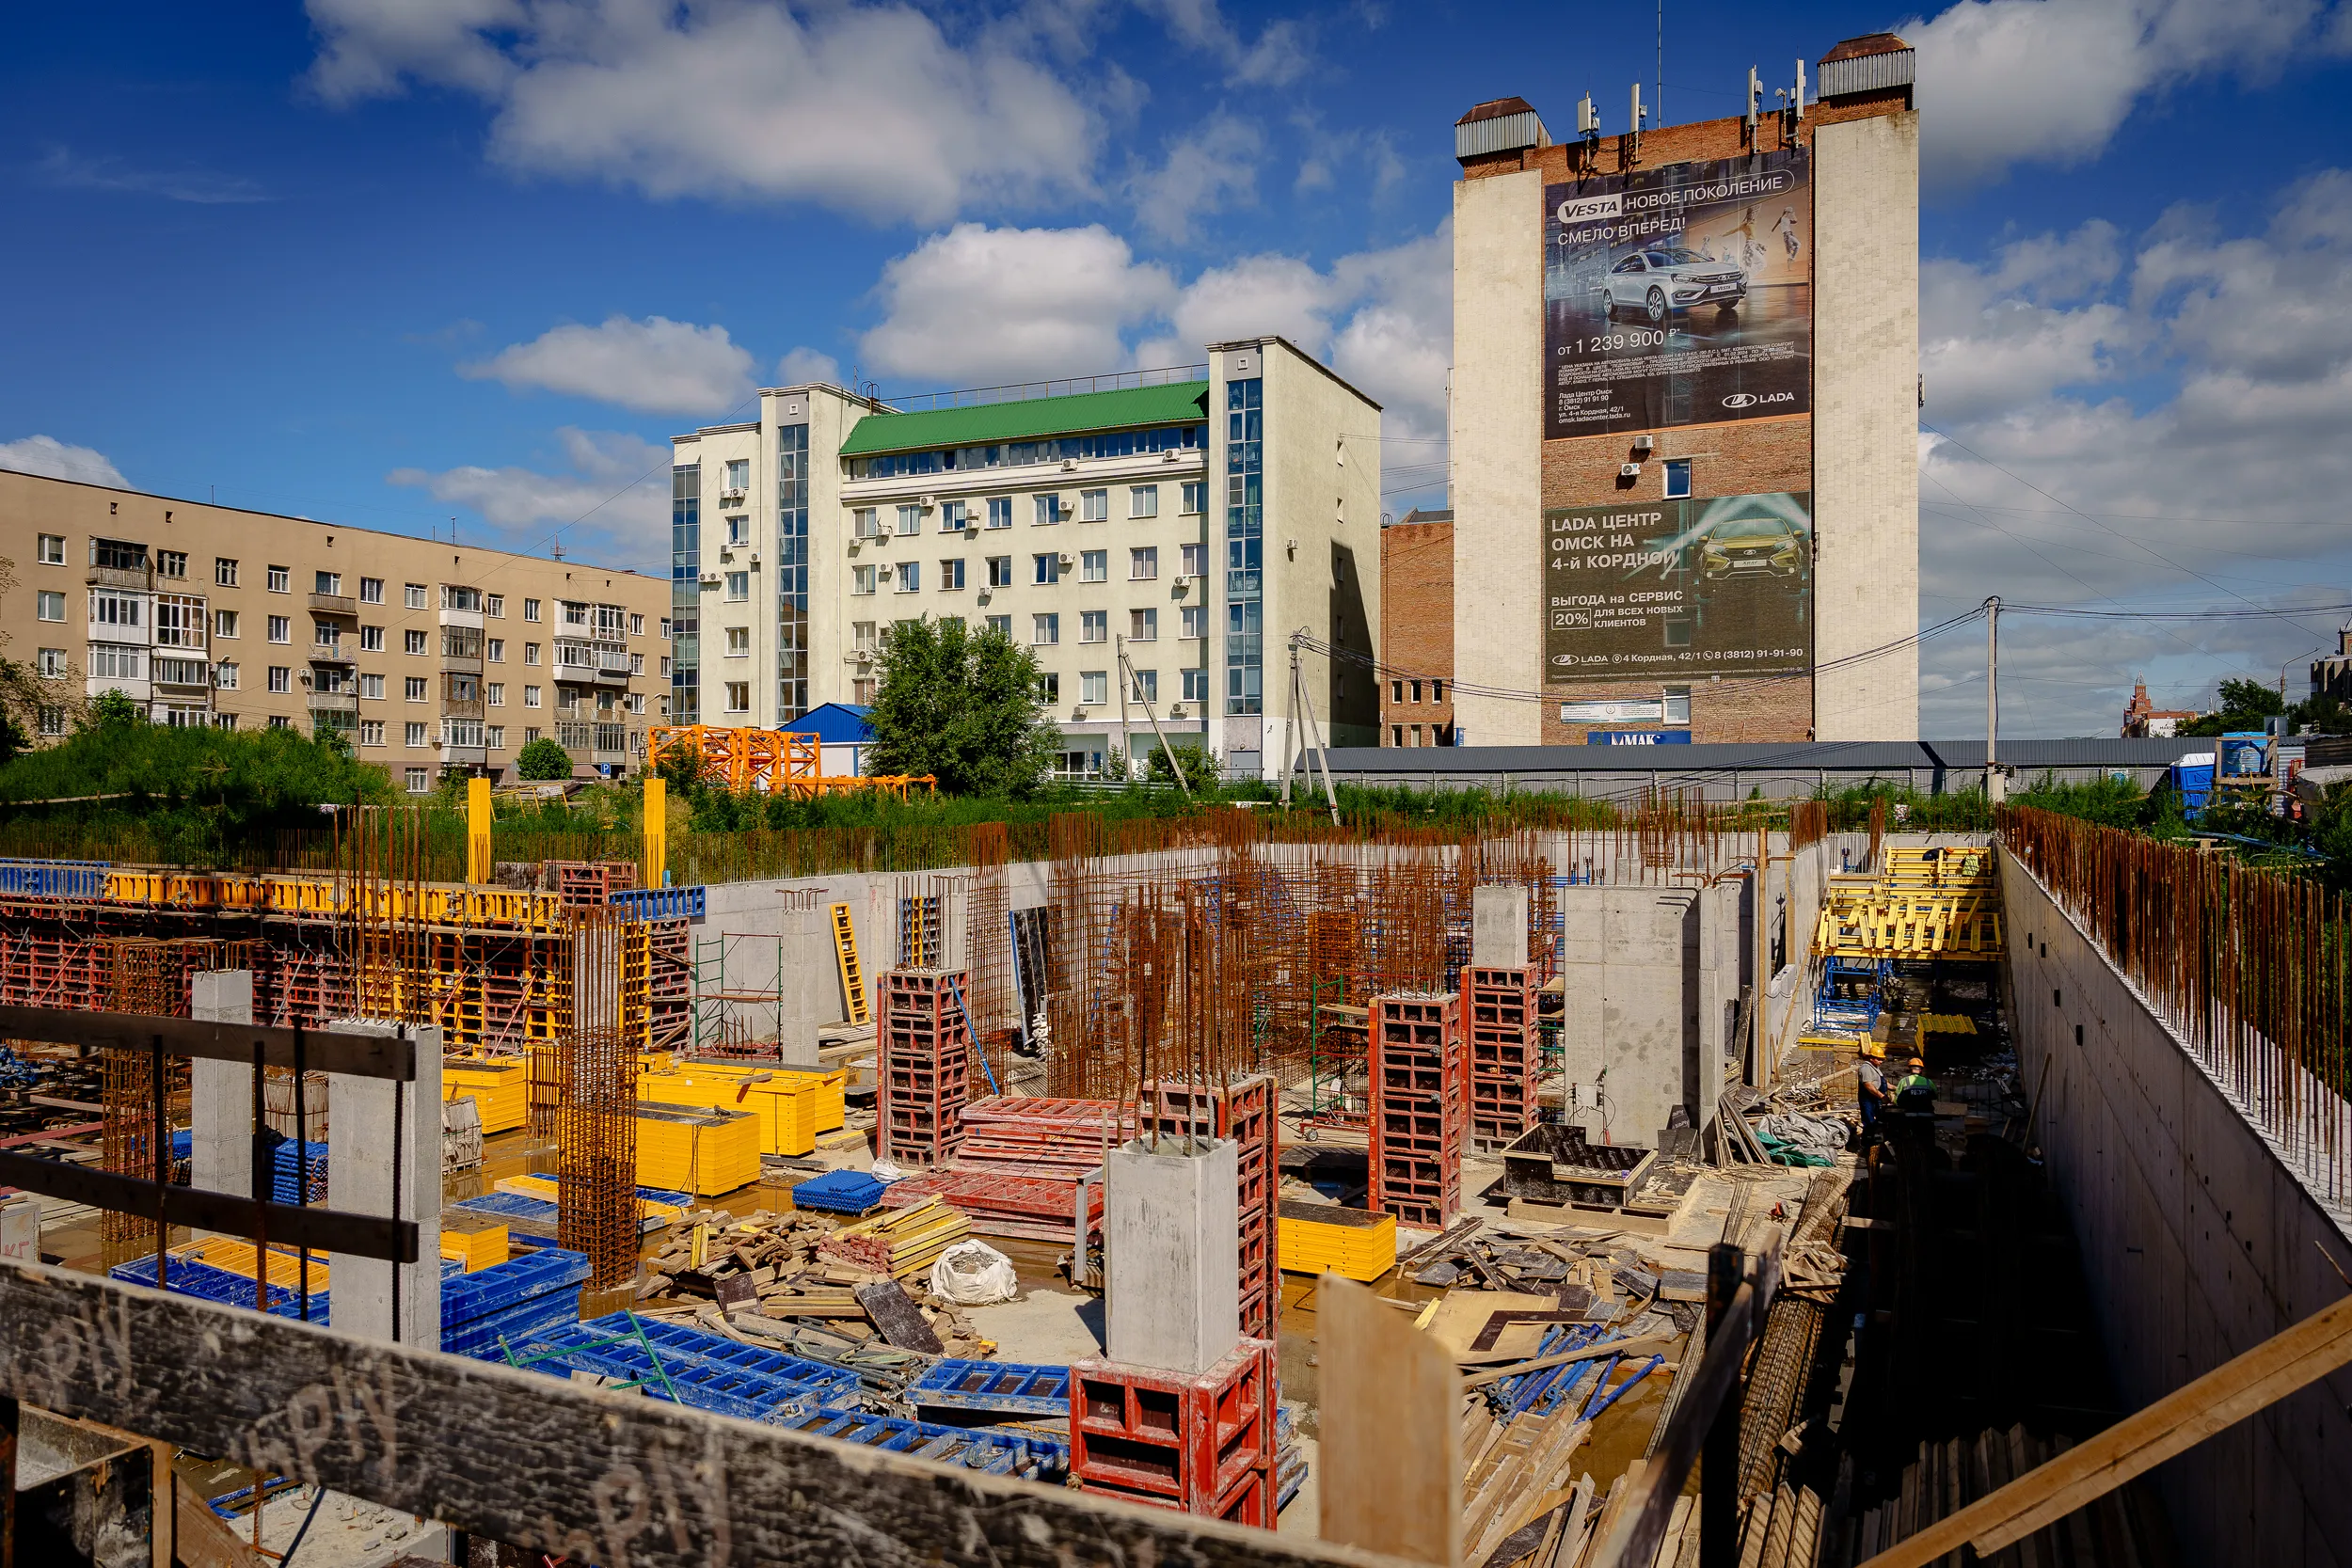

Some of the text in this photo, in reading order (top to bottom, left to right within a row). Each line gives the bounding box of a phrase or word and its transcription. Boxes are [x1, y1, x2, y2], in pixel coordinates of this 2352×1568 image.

[1627, 177, 1782, 209] НОВОЕ ПОКОЛЕНИЕ
[1565, 200, 1618, 218] VESTA
[1558, 228, 1613, 245] СМЕЛО
[1557, 346, 1572, 356] от
[1576, 339, 1582, 353] 1
[1591, 334, 1623, 352] 239
[1630, 330, 1664, 347] 900
[1760, 392, 1795, 403] LADA
[1559, 413, 1631, 424] omsk.ladacenter.lada.ru
[1552, 512, 1662, 532] LADA ЦЕНТР
[1552, 534, 1634, 551] ОМСК НА
[1552, 557, 1580, 570] 4-й
[1552, 595, 1606, 606] ВЫГОДА
[1629, 591, 1683, 602] СЕРВИС
[1594, 606, 1683, 618] ДЛЯ ВСЕХ НОВЫХ
[1555, 613, 1588, 625] 20%
[1594, 619, 1646, 628] КЛИЕНТОВ
[1631, 654, 1676, 663] Кордная,
[1678, 652, 1700, 661] 42/1
[1724, 650, 1754, 660] (3812)
[1757, 648, 1803, 657] 91-91-90
[603, 764, 609, 773] P
